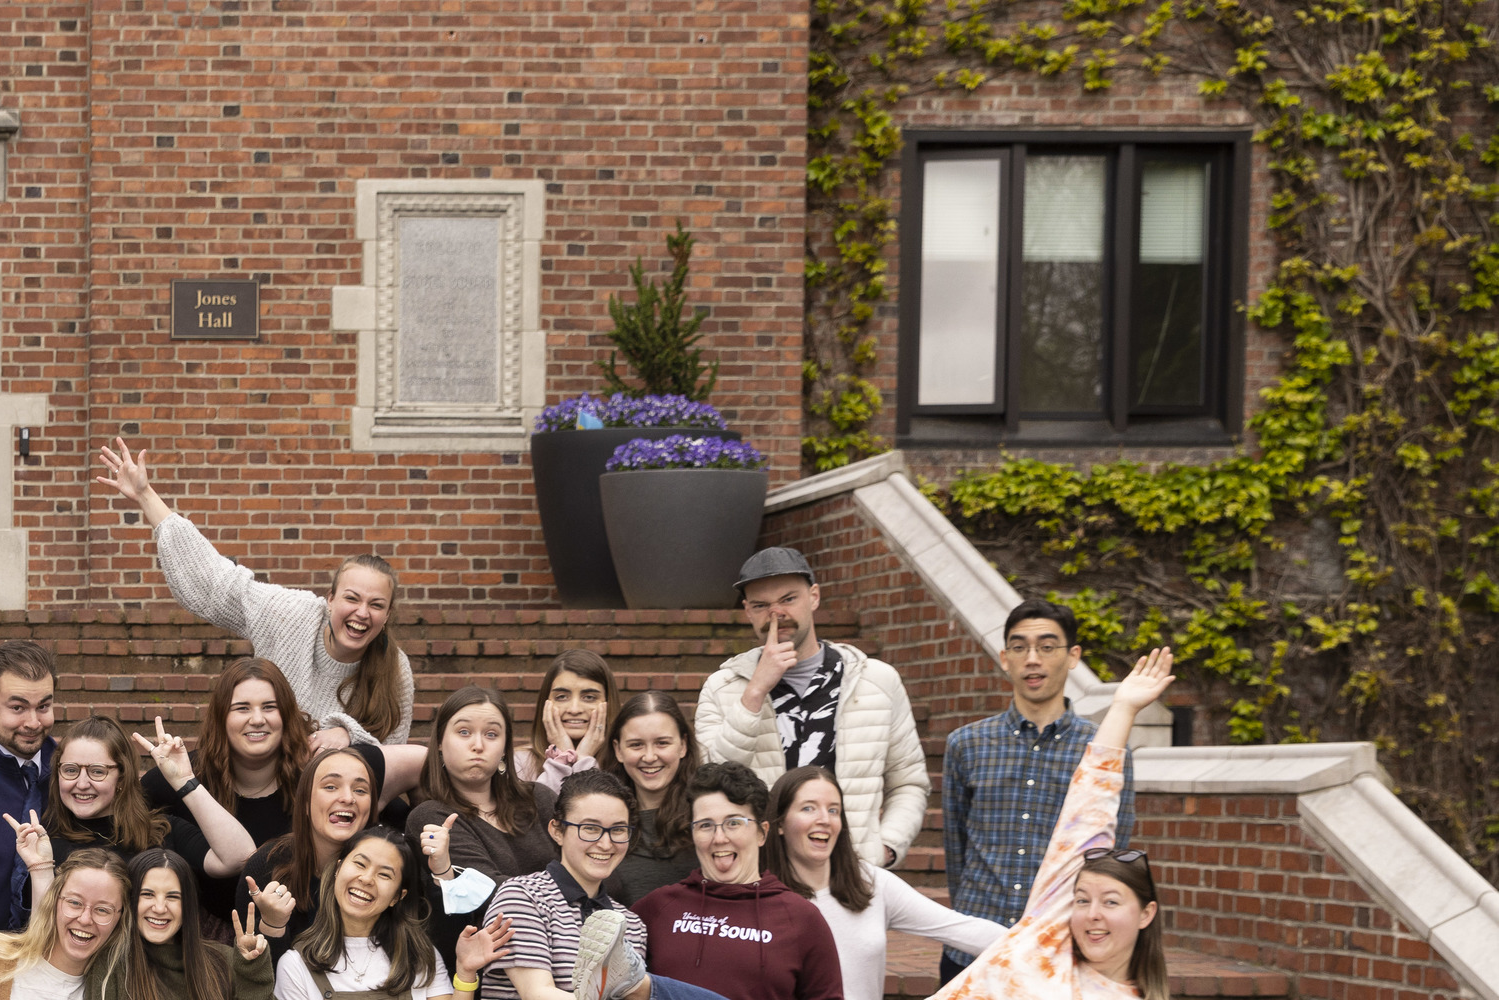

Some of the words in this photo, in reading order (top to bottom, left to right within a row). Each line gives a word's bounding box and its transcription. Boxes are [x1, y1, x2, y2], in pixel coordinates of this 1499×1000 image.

[194, 289, 237, 310] Jones
[198, 311, 232, 328] Hall
[682, 911, 717, 924] Univrsity
[672, 919, 719, 936] PUGET
[718, 924, 773, 944] SOUND
